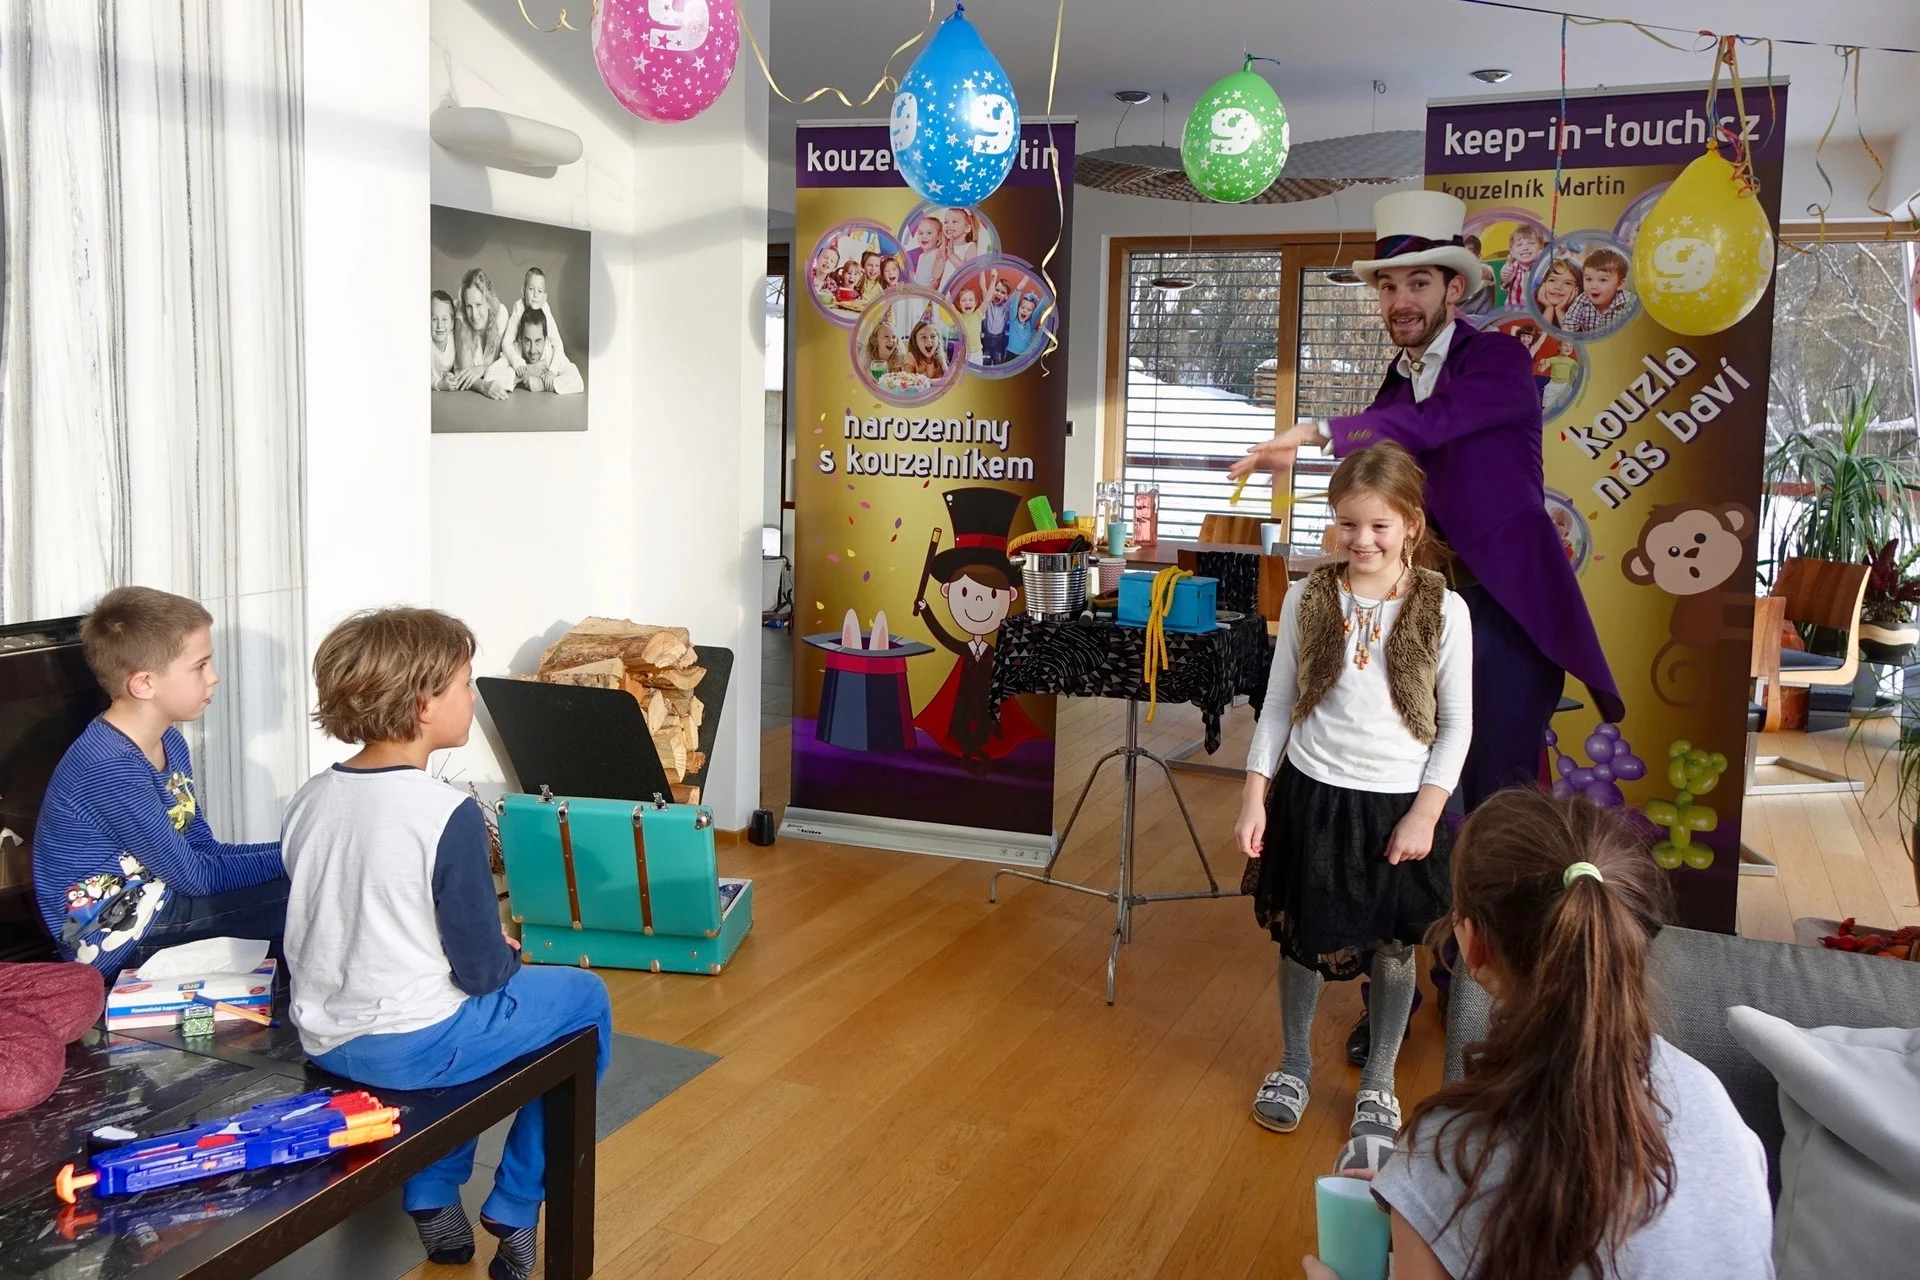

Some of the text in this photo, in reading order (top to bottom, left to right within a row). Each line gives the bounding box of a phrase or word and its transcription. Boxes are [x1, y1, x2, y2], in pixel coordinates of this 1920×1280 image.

[648, 0, 710, 51] 9
[970, 94, 1015, 155] 9
[1210, 107, 1256, 155] 9
[1444, 109, 1760, 162] keep-in-touch.cz
[807, 138, 1060, 172] kouze tin
[1442, 175, 1626, 200] kouzelník Martin
[1654, 237, 1716, 293] 9
[1565, 346, 1698, 459] kouzla
[844, 411, 1011, 450] narozeniny
[1592, 356, 1751, 509] nás baví
[819, 444, 1034, 480] s kouzelníkem
